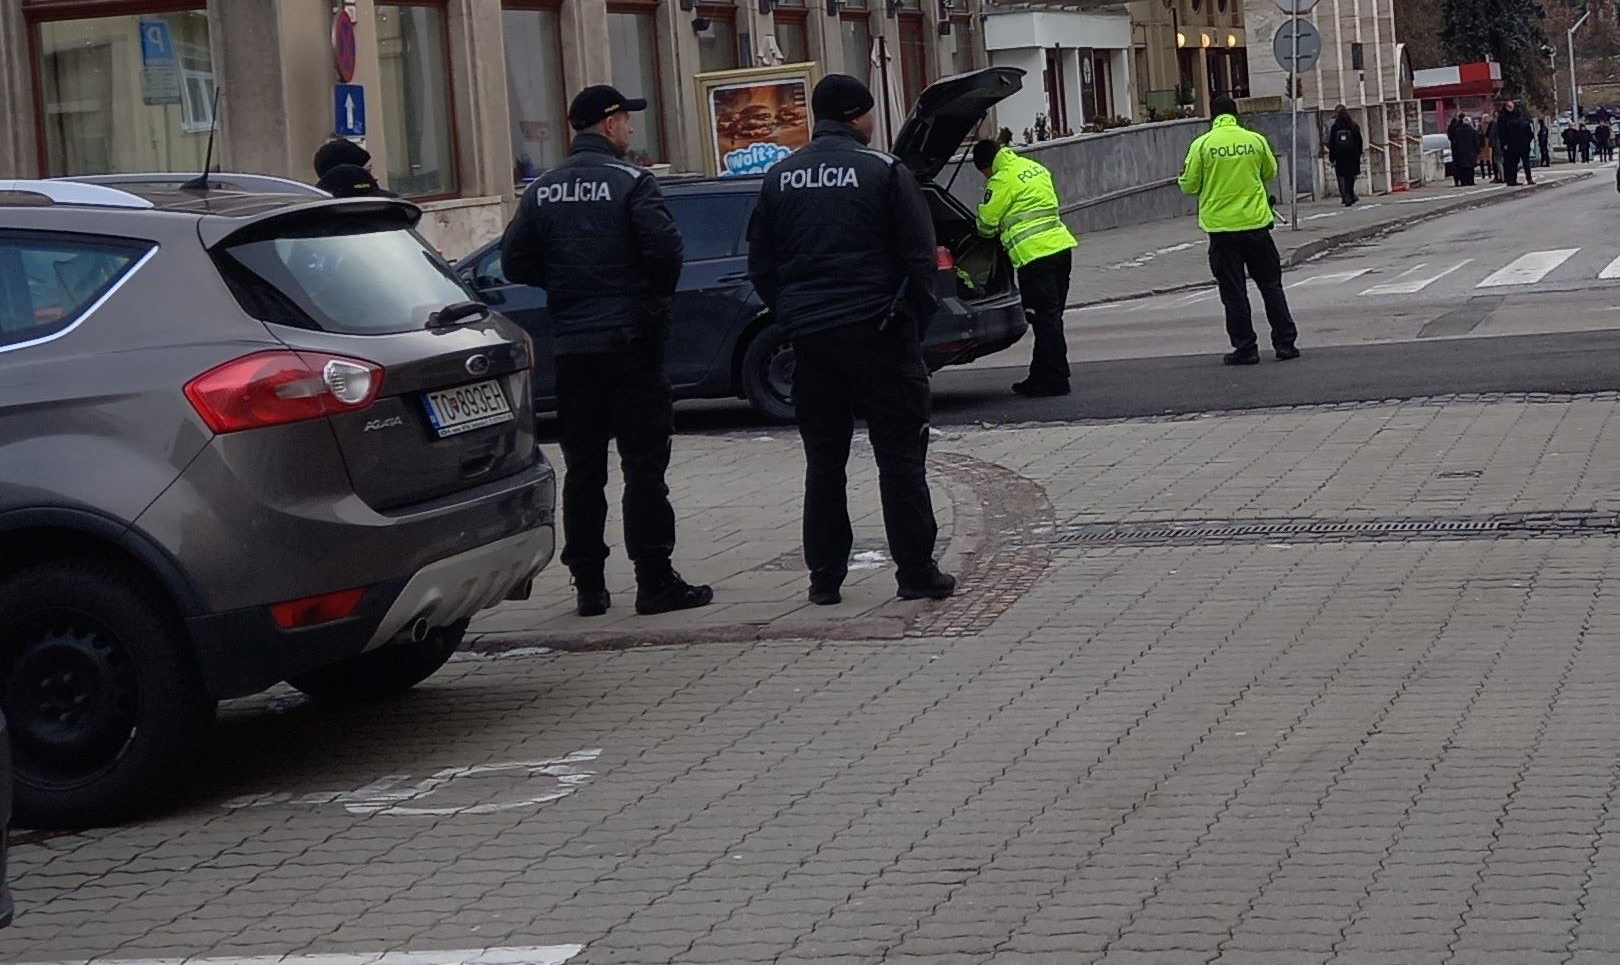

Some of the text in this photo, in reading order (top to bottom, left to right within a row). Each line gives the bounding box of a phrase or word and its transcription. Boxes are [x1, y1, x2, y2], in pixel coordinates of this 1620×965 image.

[1209, 143, 1256, 160] POLÍCIA
[780, 163, 859, 192] POLÍCIA
[536, 178, 612, 207] POLÍCIA
